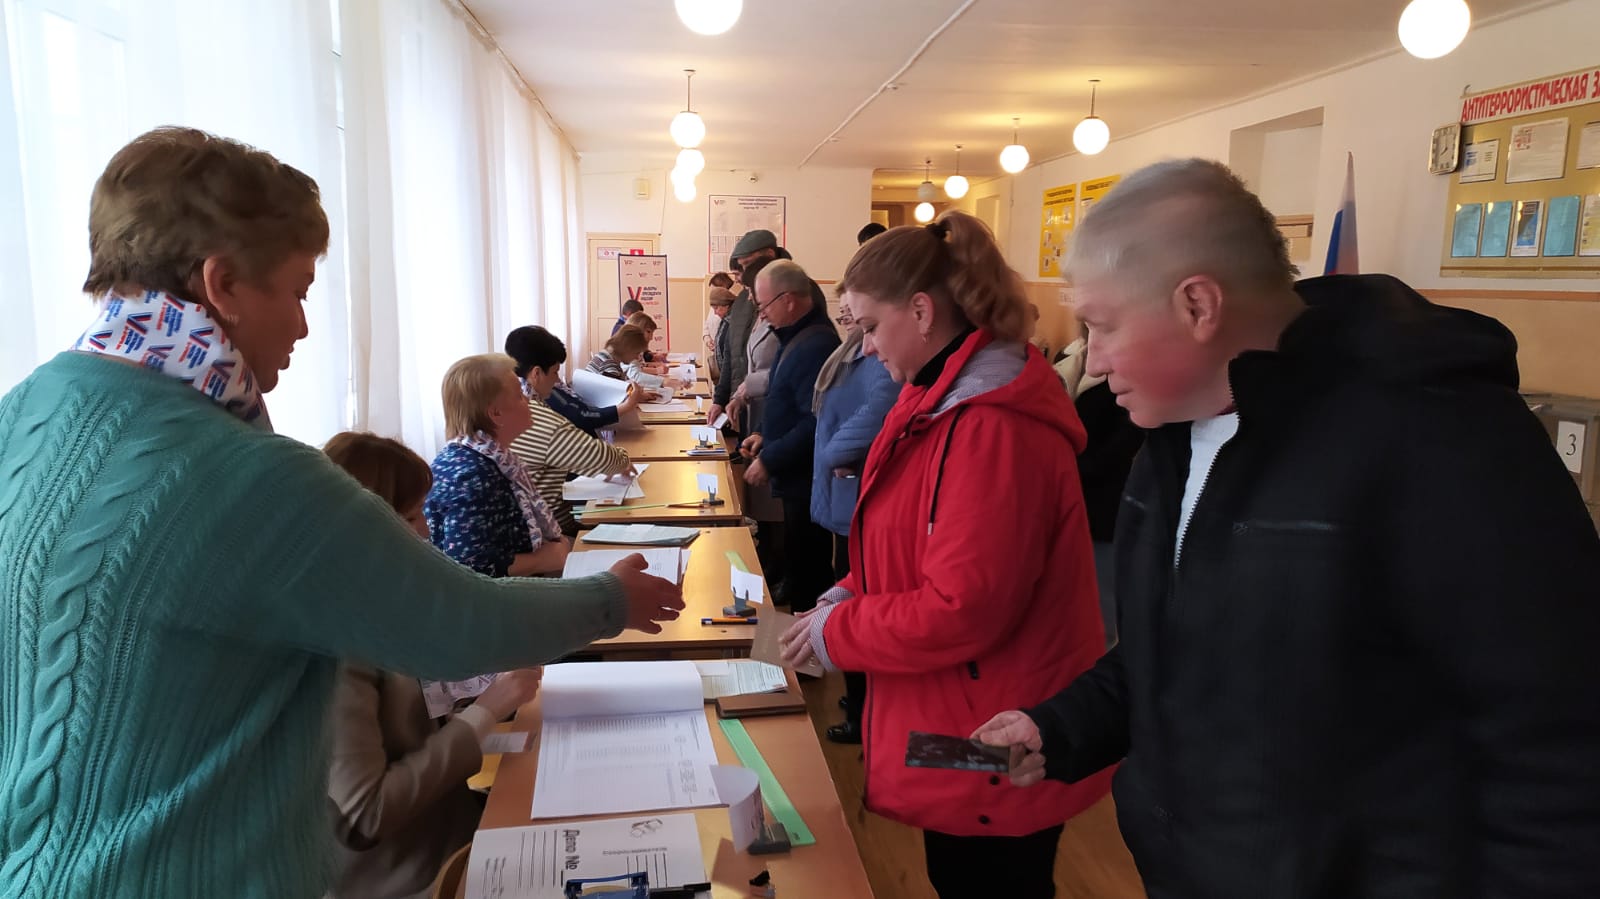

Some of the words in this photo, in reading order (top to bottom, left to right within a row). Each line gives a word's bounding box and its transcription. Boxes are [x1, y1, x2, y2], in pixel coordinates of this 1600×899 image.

[1461, 73, 1589, 121] АНТИТЕРРОРИСТИЧЕСКАЯ
[1592, 70, 1600, 98] З
[1566, 433, 1577, 455] 3
